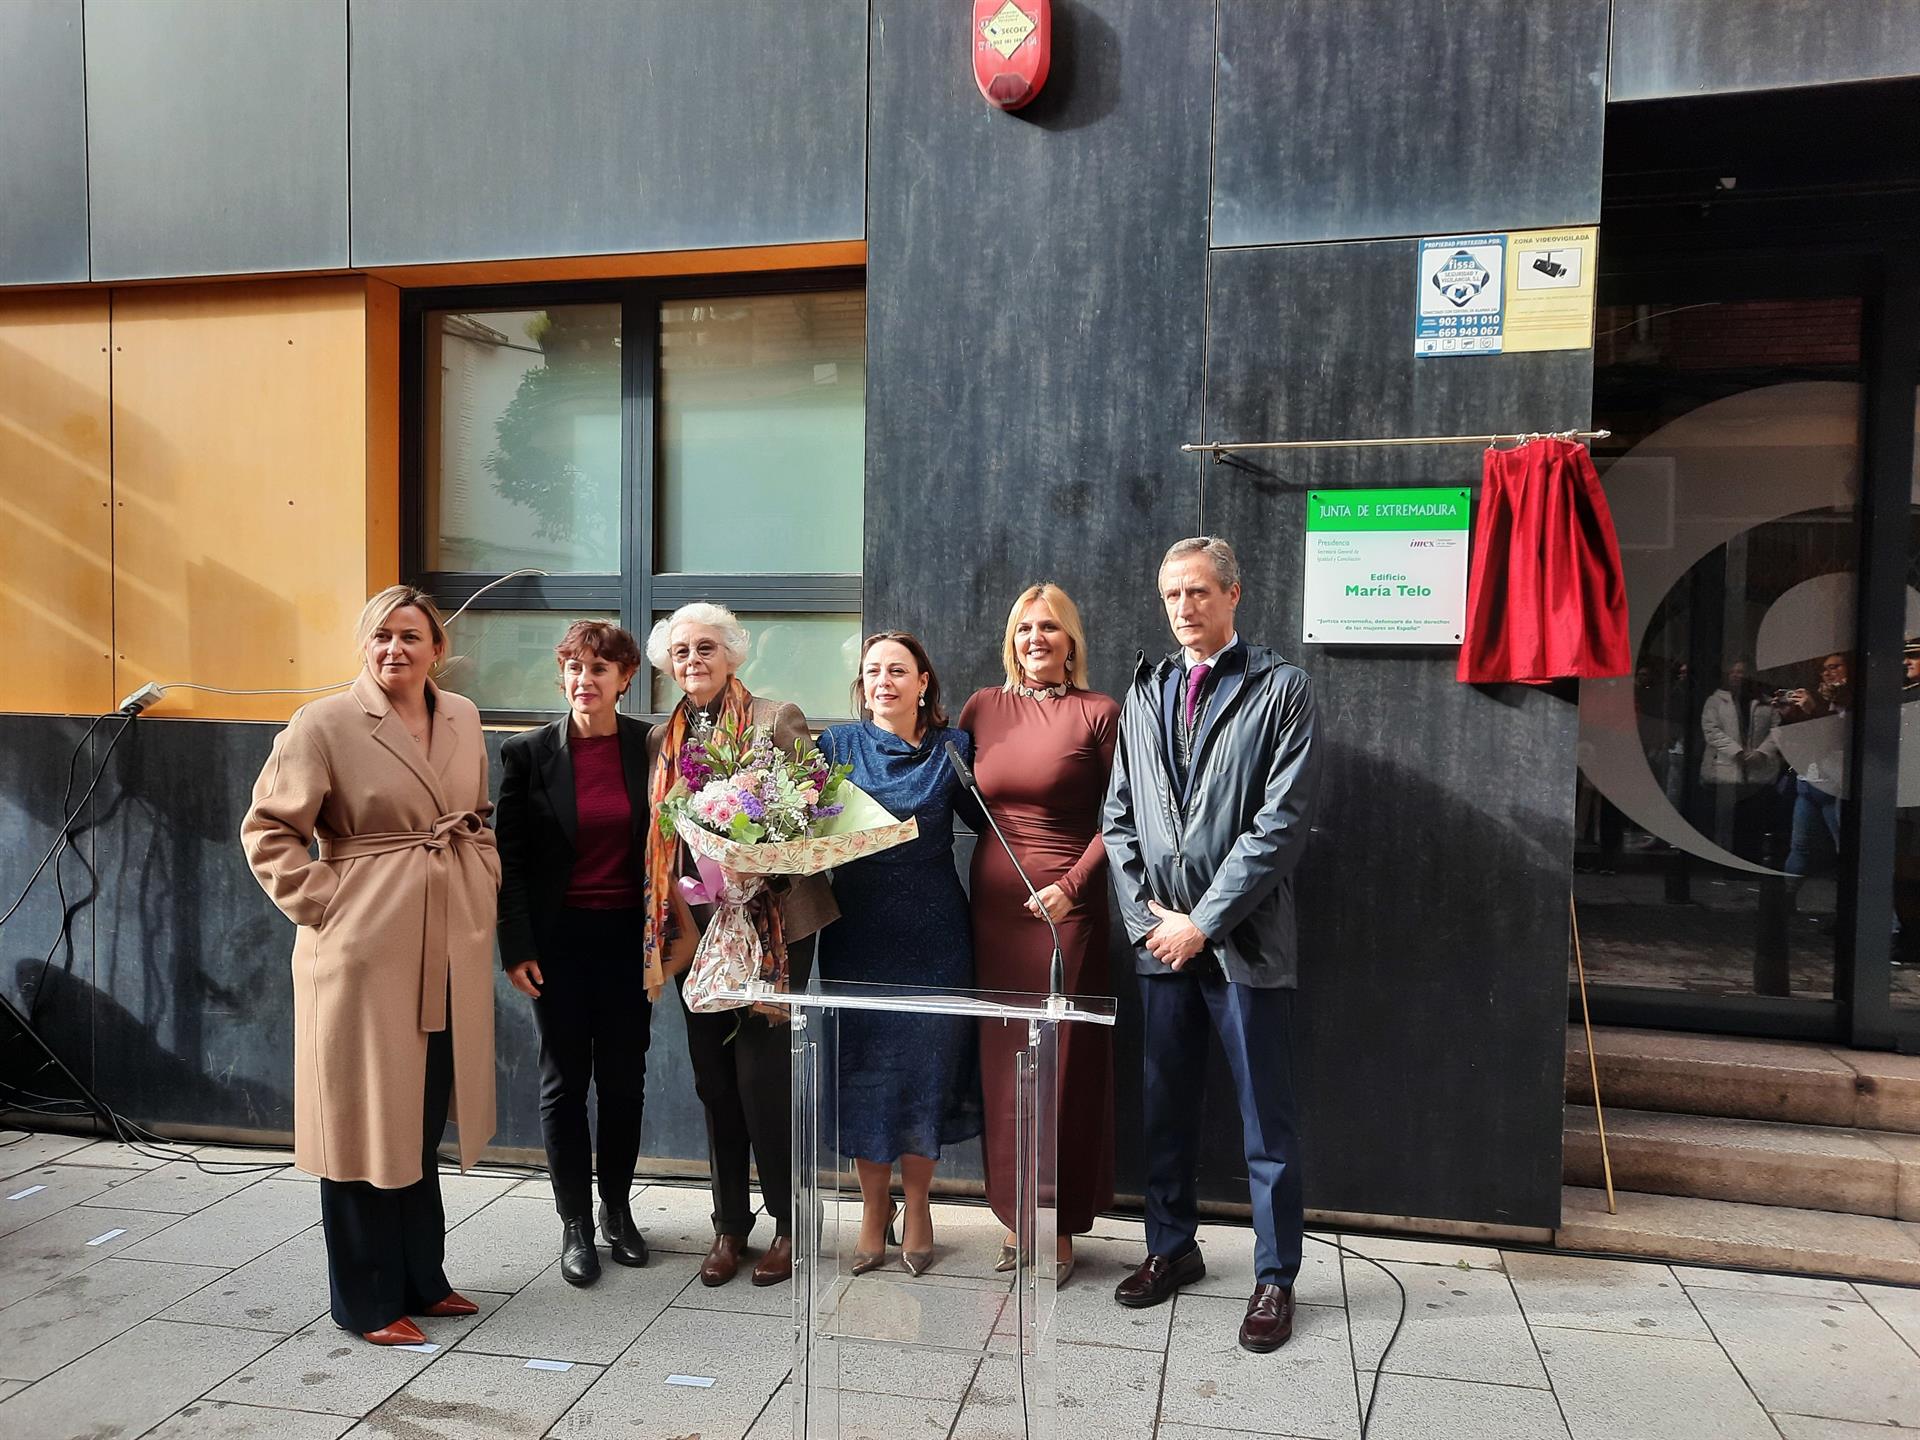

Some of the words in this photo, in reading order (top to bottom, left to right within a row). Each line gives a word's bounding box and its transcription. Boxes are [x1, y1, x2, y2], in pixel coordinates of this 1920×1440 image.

[1513, 237, 1534, 245] ZONA
[1535, 234, 1590, 243] VIDEOVIGILADA
[1448, 259, 1476, 270] fissa
[1438, 317, 1457, 326] 902
[1460, 316, 1478, 325] 191
[1480, 315, 1500, 324] 010
[1438, 328, 1457, 337] 669
[1459, 327, 1478, 336] 949
[1480, 326, 1500, 335] 067
[1319, 504, 1351, 518] JUNTA
[1357, 504, 1369, 517] DE
[1376, 503, 1457, 517] EXTREMADURA
[1370, 573, 1406, 581] Edificio
[1345, 584, 1391, 597] María
[1397, 585, 1432, 597] Telo
